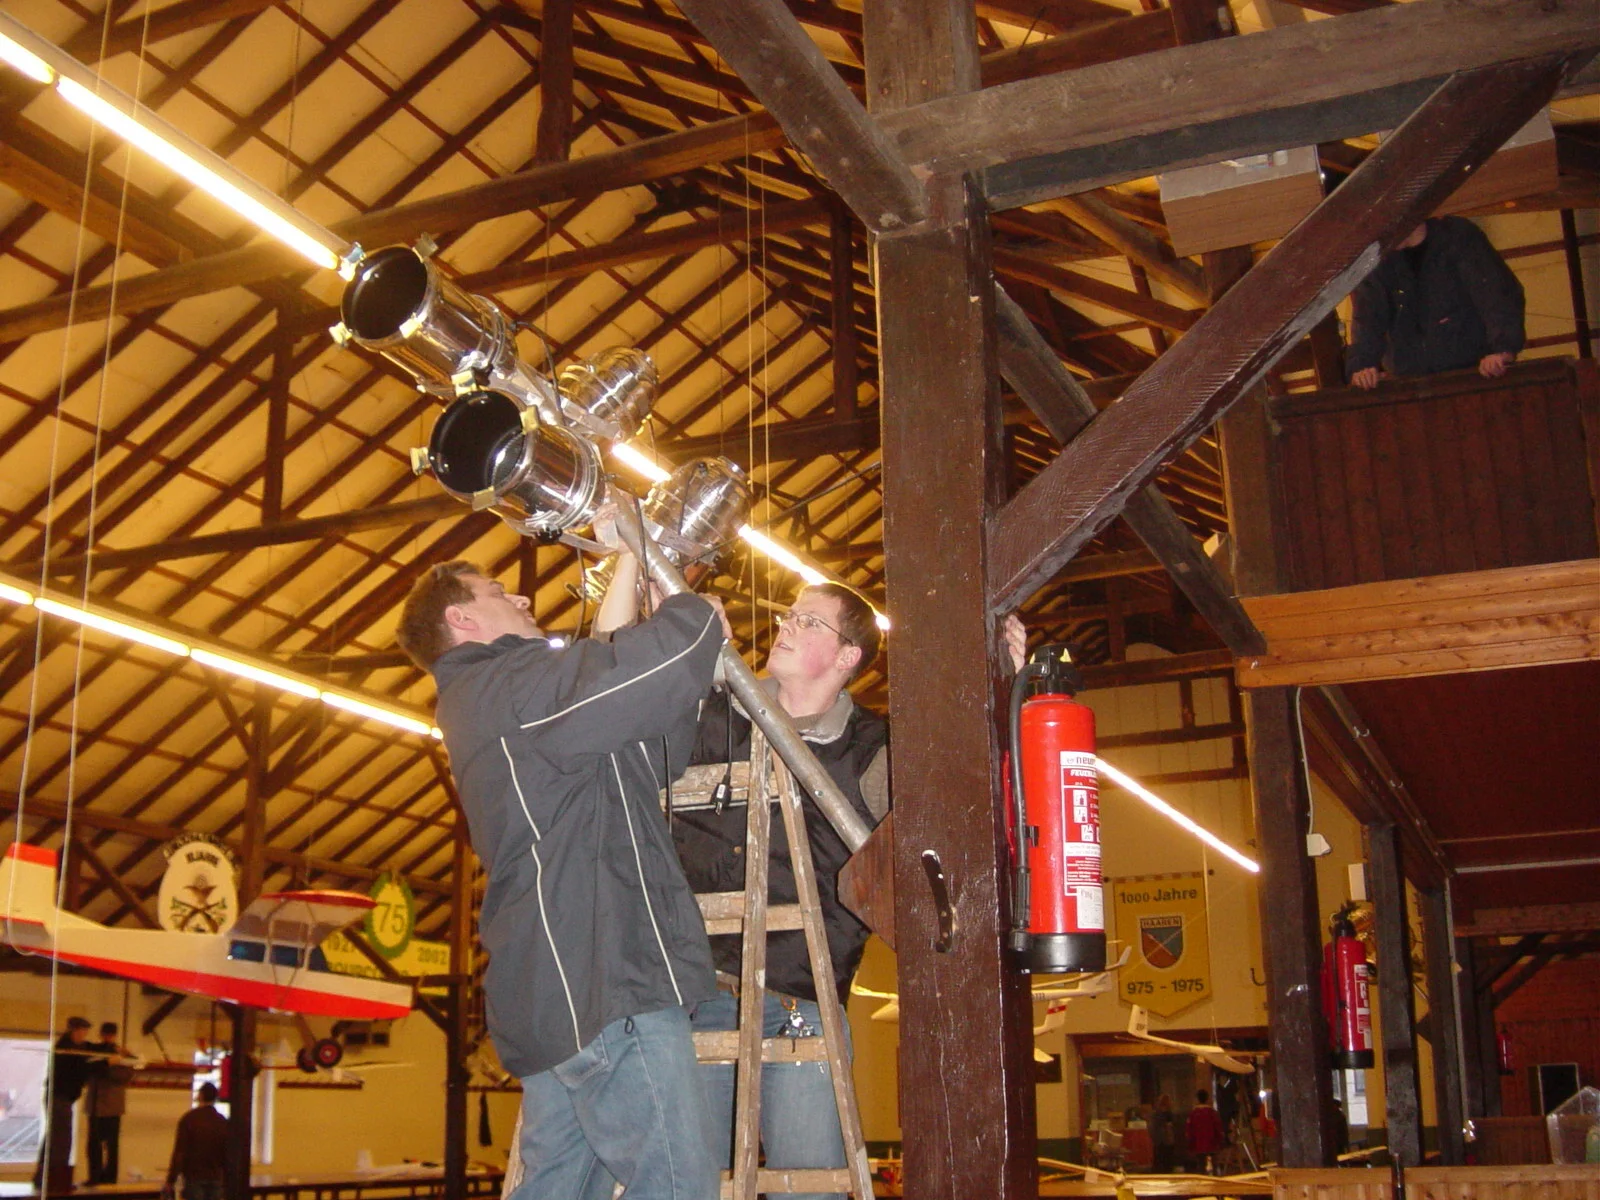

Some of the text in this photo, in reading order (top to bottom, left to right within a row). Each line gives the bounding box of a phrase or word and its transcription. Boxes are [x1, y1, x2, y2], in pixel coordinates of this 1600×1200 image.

[1119, 887, 1198, 905] 1000 Jahre
[377, 901, 405, 934] 75
[1127, 980, 1154, 995] 975
[1171, 978, 1204, 993] 1975
